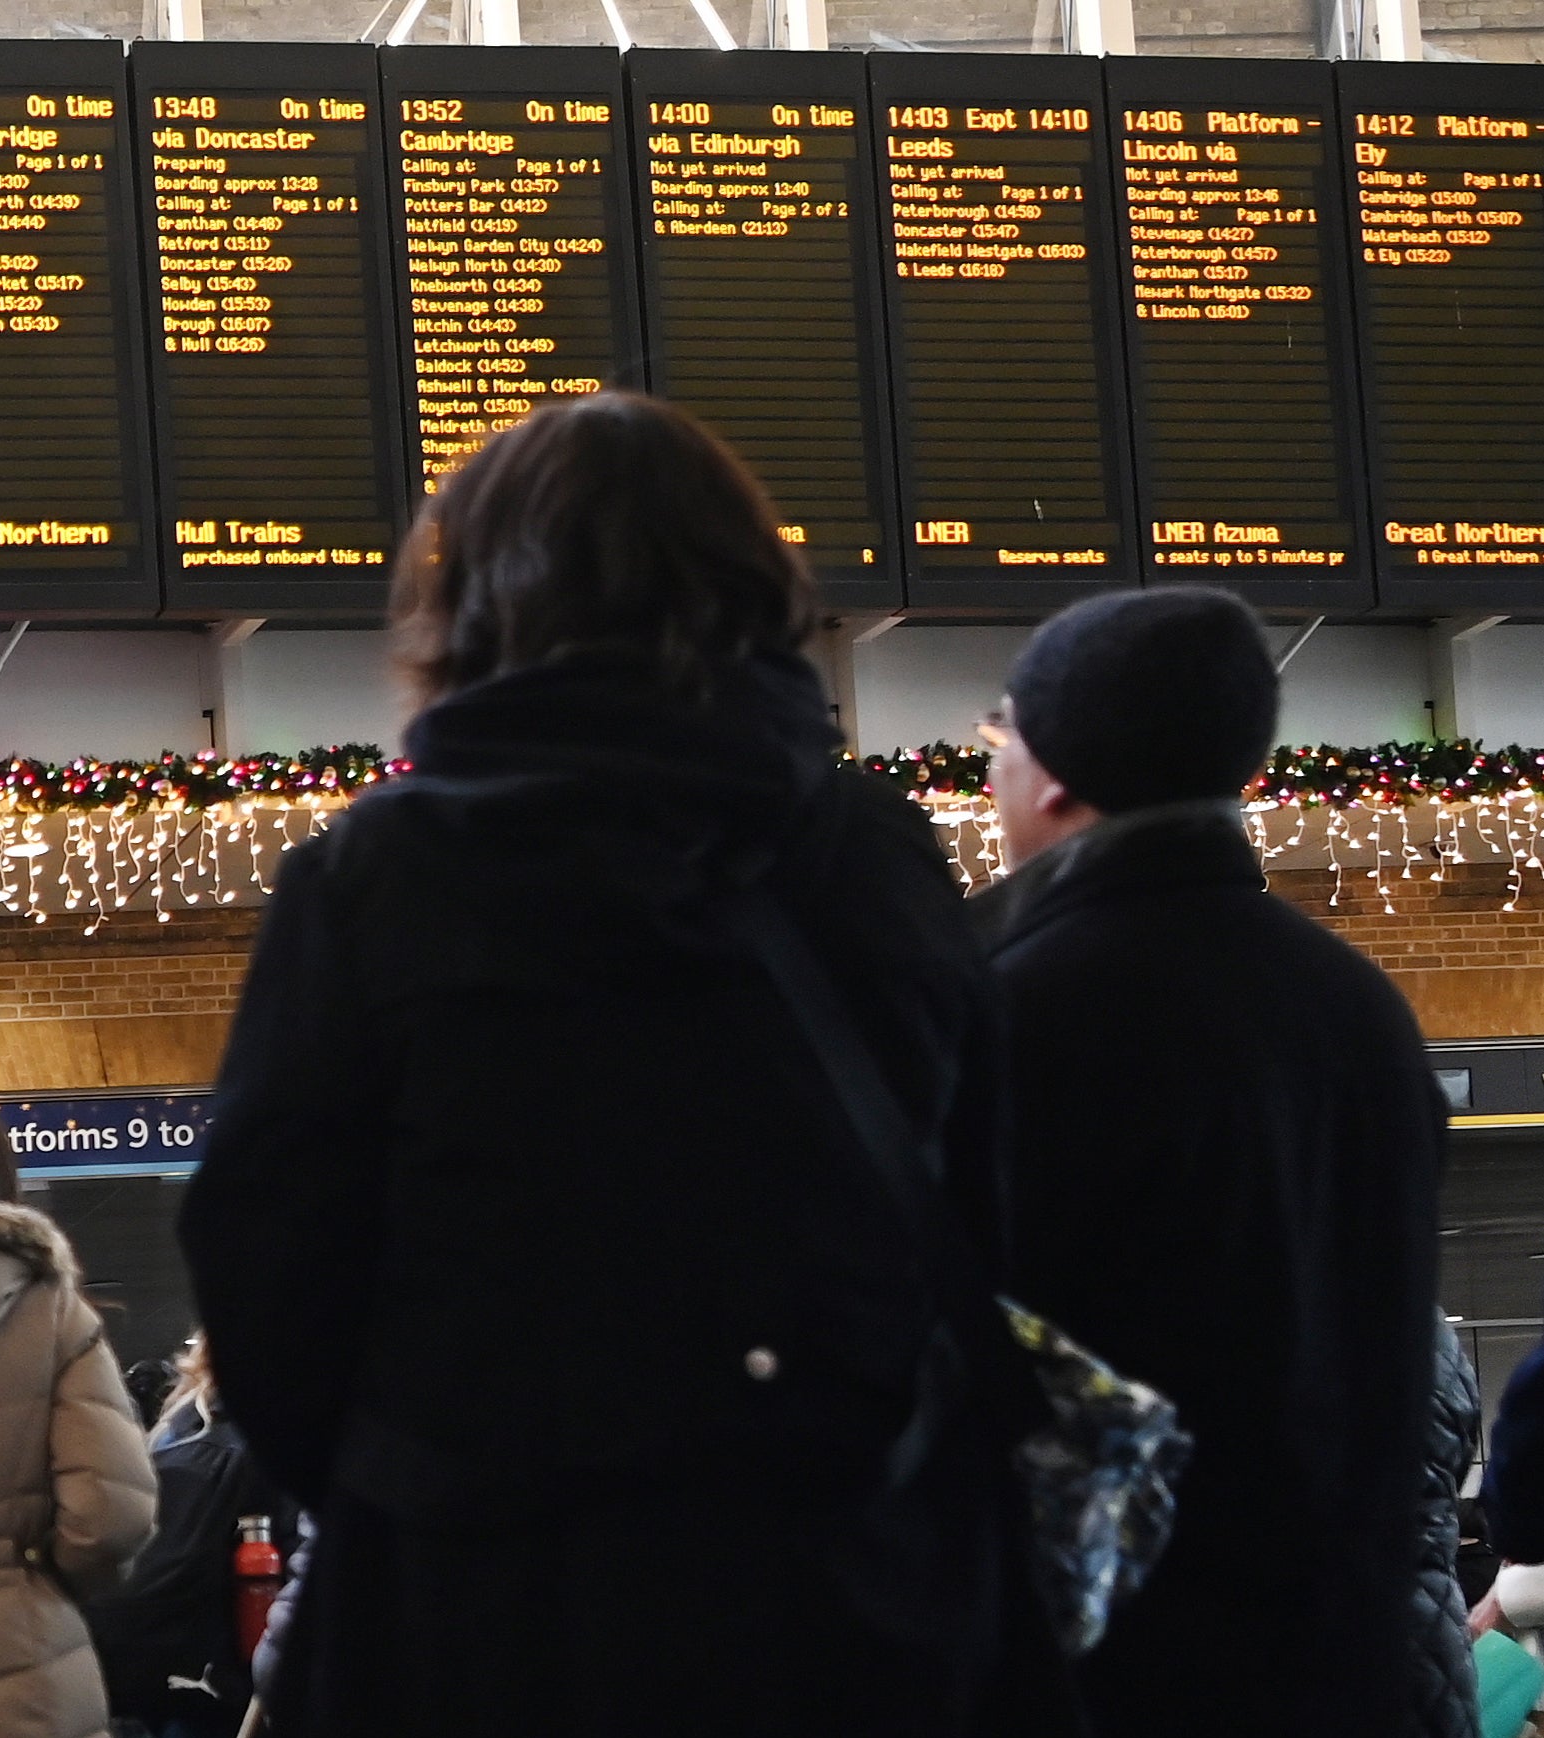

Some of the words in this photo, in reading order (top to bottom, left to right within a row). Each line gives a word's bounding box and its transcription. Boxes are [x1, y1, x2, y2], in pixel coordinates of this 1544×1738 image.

[27, 94, 57, 118] On
[65, 95, 114, 118] time
[154, 96, 217, 119] 13:48
[282, 97, 310, 120] On
[318, 98, 366, 120] time
[402, 99, 464, 122] 13:52
[525, 100, 556, 122] On
[564, 101, 610, 123] time
[650, 103, 710, 125] 14:00
[771, 104, 801, 127] On
[809, 105, 855, 127] time
[889, 107, 950, 129] 14:03
[965, 107, 1018, 133] Expt
[1029, 109, 1089, 131] 14:10
[1125, 110, 1184, 132] 14:06
[1207, 111, 1300, 134] Platform
[1356, 114, 1415, 136] 14:12
[1437, 115, 1528, 138] Platform
[153, 127, 186, 149] via
[195, 126, 316, 150] Doncaster
[402, 129, 515, 155] Cambridge
[650, 133, 682, 154] via
[690, 132, 801, 159] Edinburgh
[889, 135, 955, 158] Leeds
[1123, 139, 1198, 162] Lincoln
[1205, 141, 1238, 162] via
[1355, 142, 1388, 167] Ely
[655, 219, 666, 235] &
[669, 220, 737, 235] Aberdeen
[741, 221, 789, 236] (21:13)
[160, 235, 220, 252] Retford
[224, 235, 271, 252] (15:11)
[10, 315, 60, 332] (15:31)
[165, 316, 217, 336] Brough
[220, 316, 272, 333] (16:07)
[177, 520, 217, 544] Hull
[225, 520, 303, 544] Trains
[915, 521, 970, 544] LNER
[1154, 521, 1206, 543] LNER
[1213, 522, 1281, 544] Azuma
[1385, 521, 1448, 544] Great
[126, 1117, 150, 1149] 9
[157, 1119, 195, 1148] to
